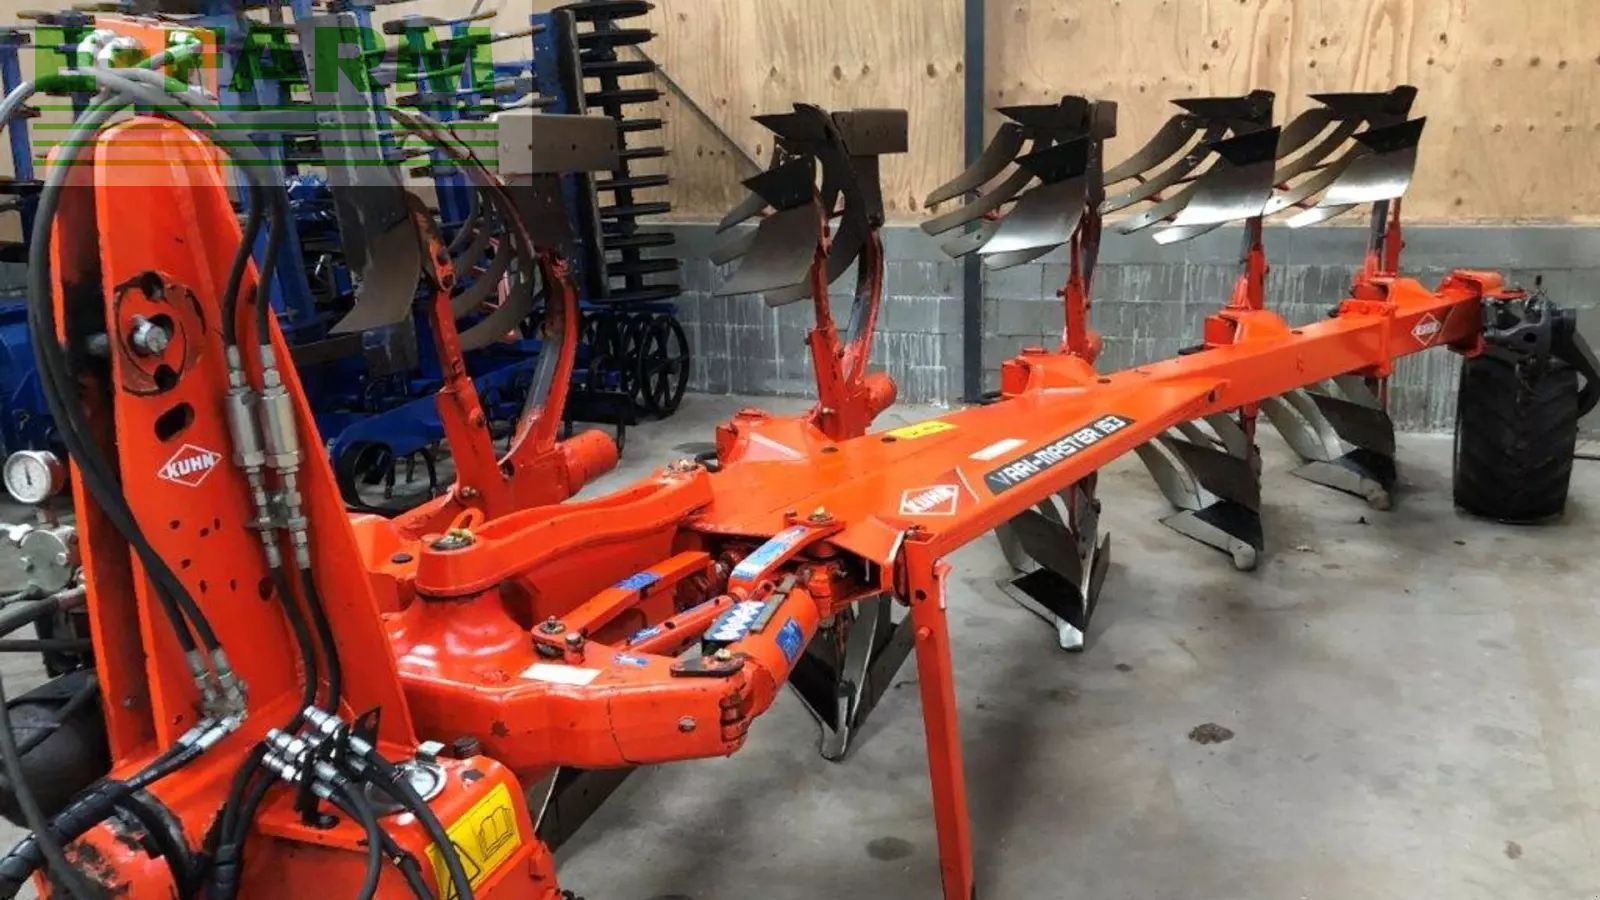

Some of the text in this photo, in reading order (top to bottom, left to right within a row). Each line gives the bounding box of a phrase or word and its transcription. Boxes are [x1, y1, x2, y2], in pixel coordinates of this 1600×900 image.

[166, 452, 215, 478] KUHN
[989, 415, 1127, 485] VARI-MASTER 153
